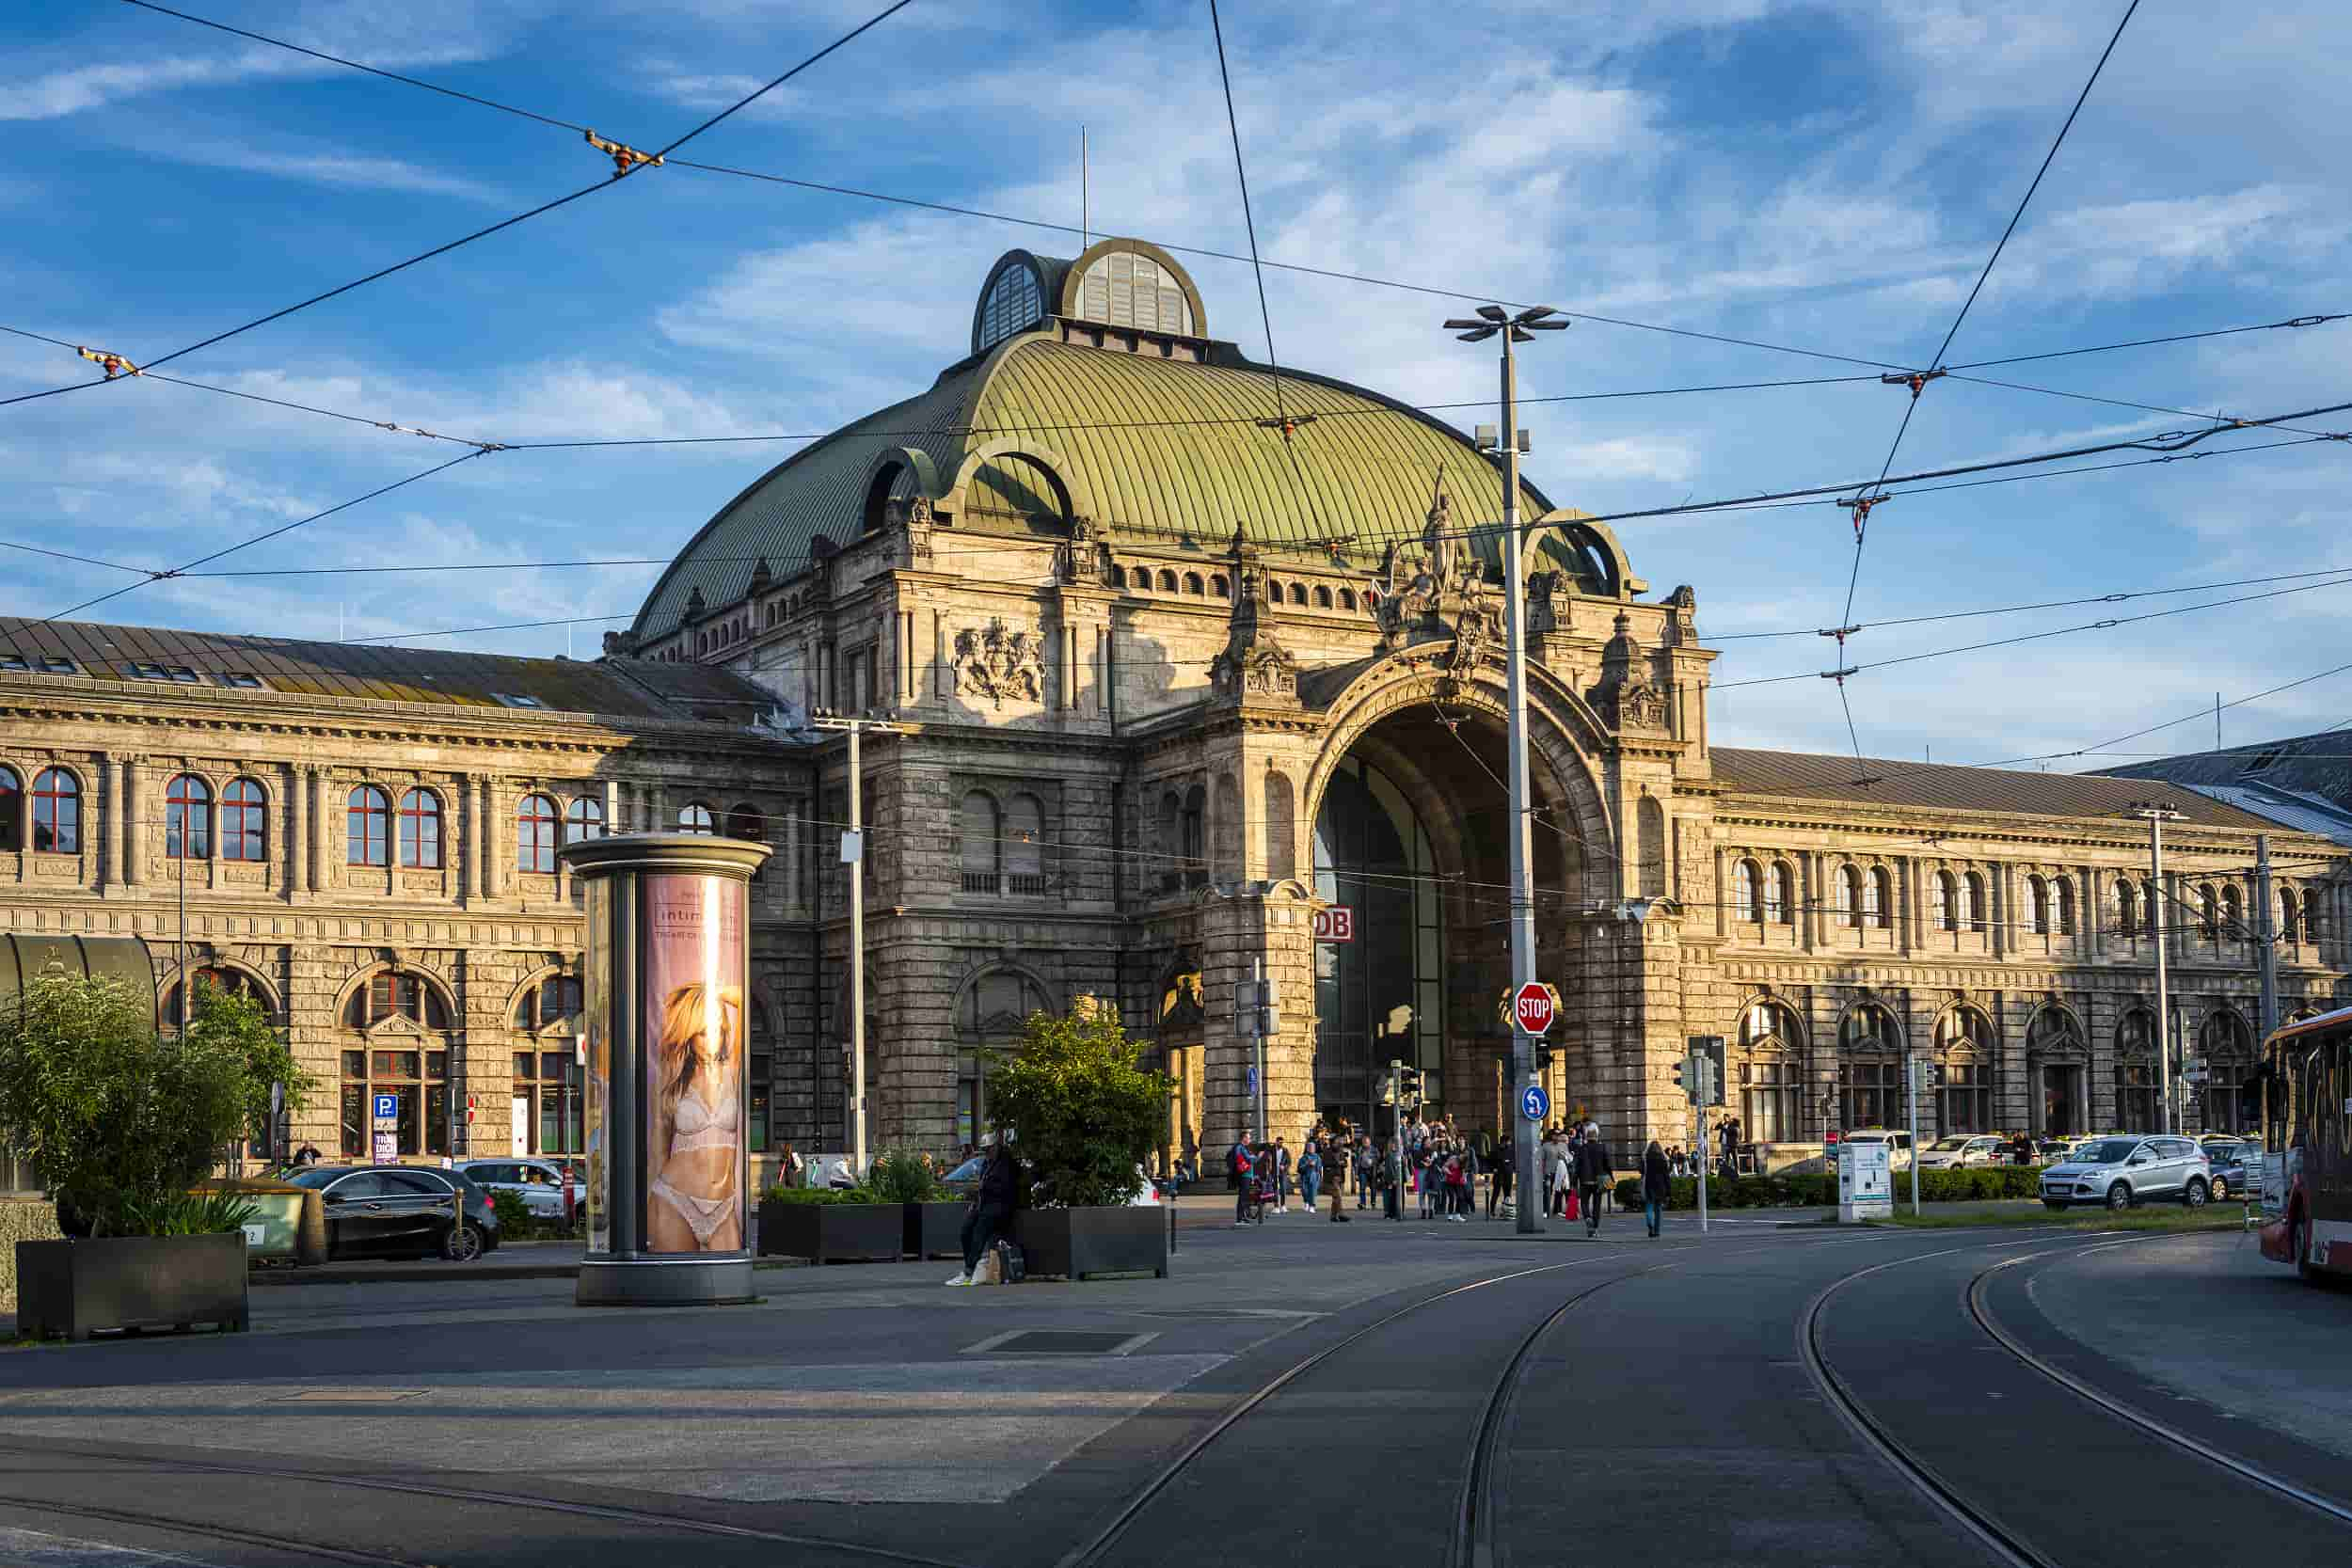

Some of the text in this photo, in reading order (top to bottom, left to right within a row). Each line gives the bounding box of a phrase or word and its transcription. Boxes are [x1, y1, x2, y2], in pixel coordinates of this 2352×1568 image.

[1316, 911, 1348, 936] DB
[1519, 997, 1549, 1019] STOP
[379, 1098, 392, 1115] P
